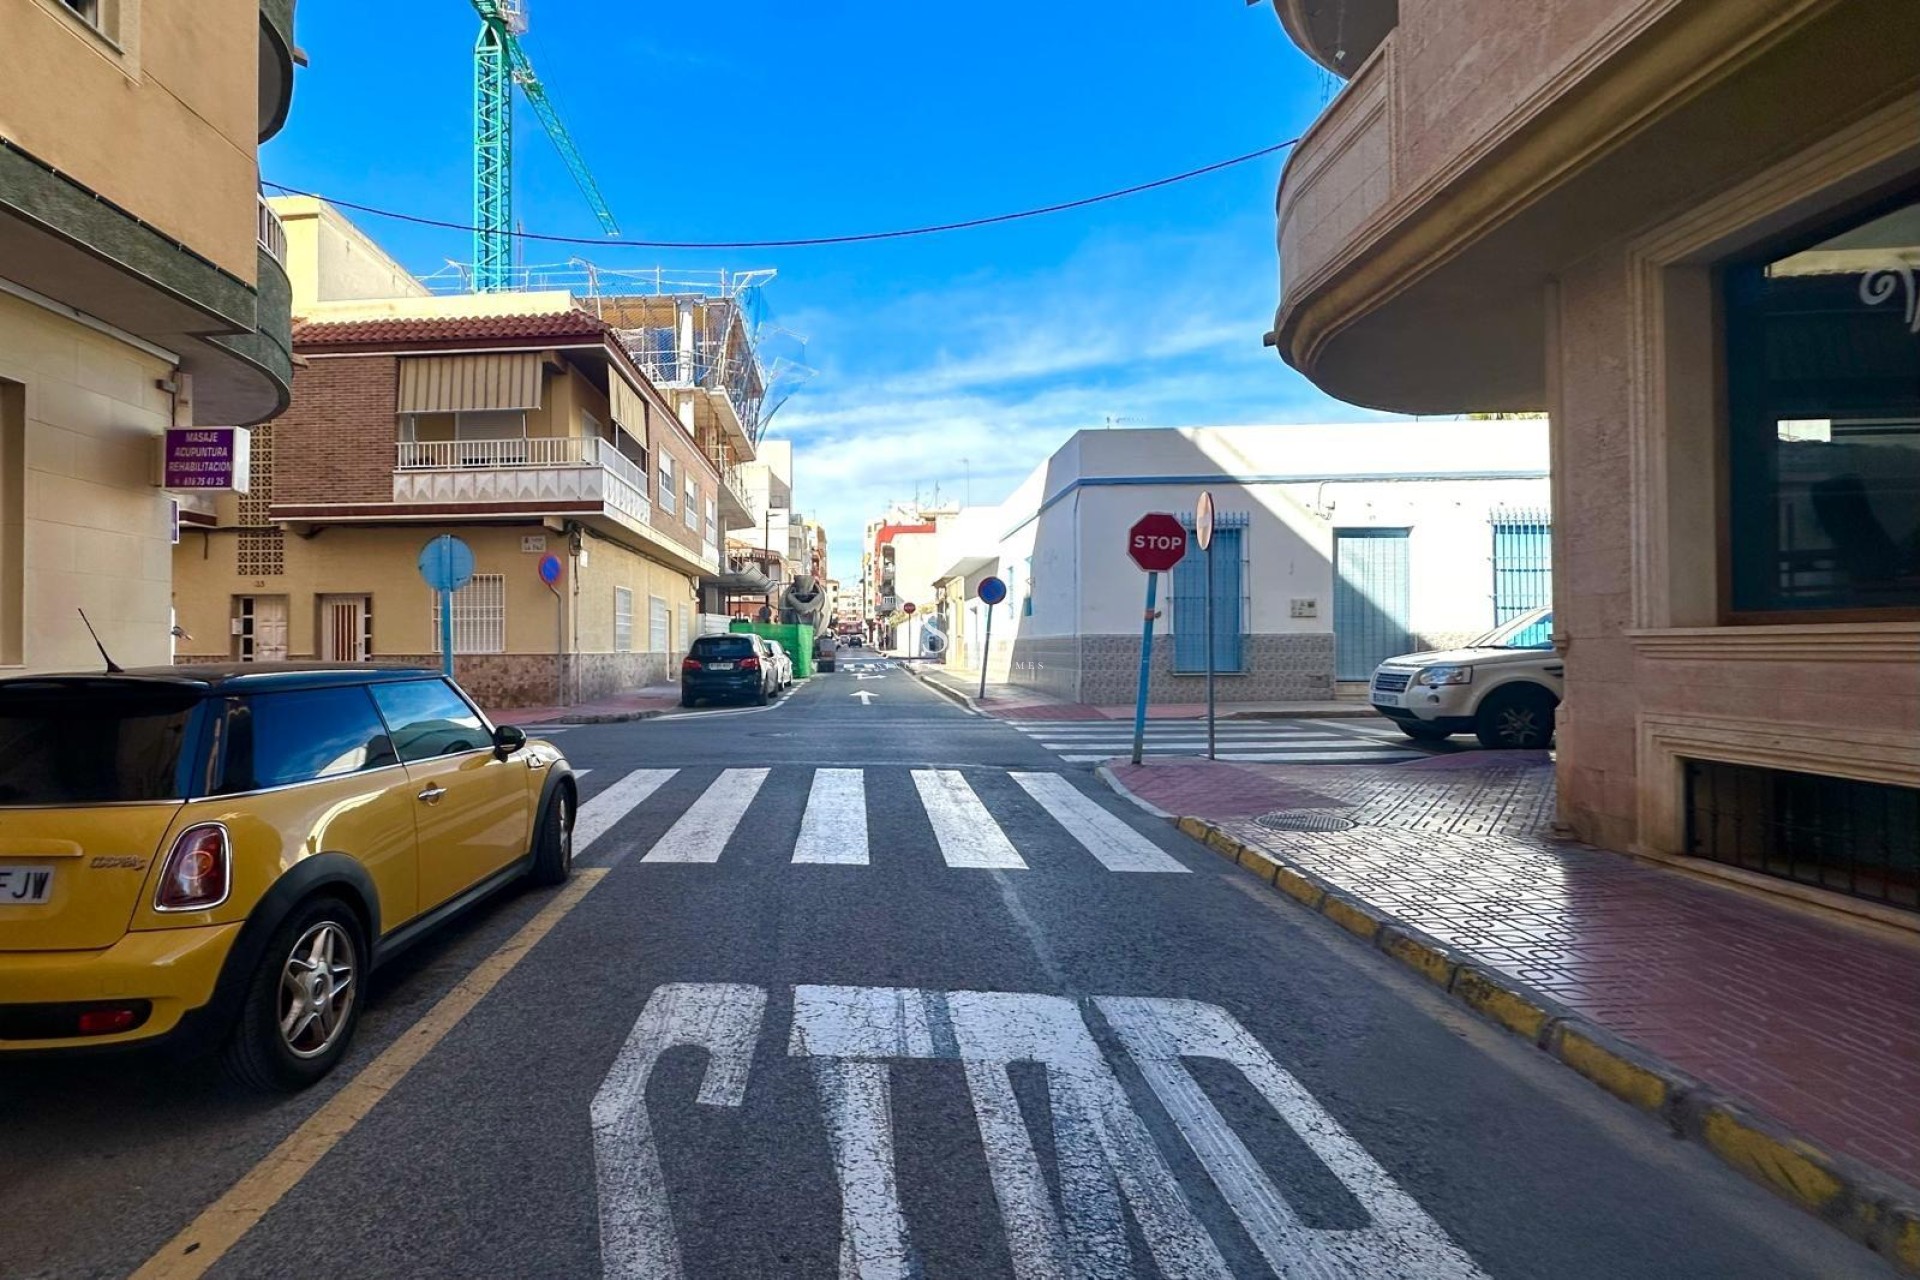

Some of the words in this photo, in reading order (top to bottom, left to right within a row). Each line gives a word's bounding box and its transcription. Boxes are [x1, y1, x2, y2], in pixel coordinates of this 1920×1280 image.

[185, 431, 218, 443] MASAJE
[174, 446, 228, 457] ACUPUNTURA
[168, 461, 232, 472] REHABILITACION
[1134, 535, 1182, 550] STOP
